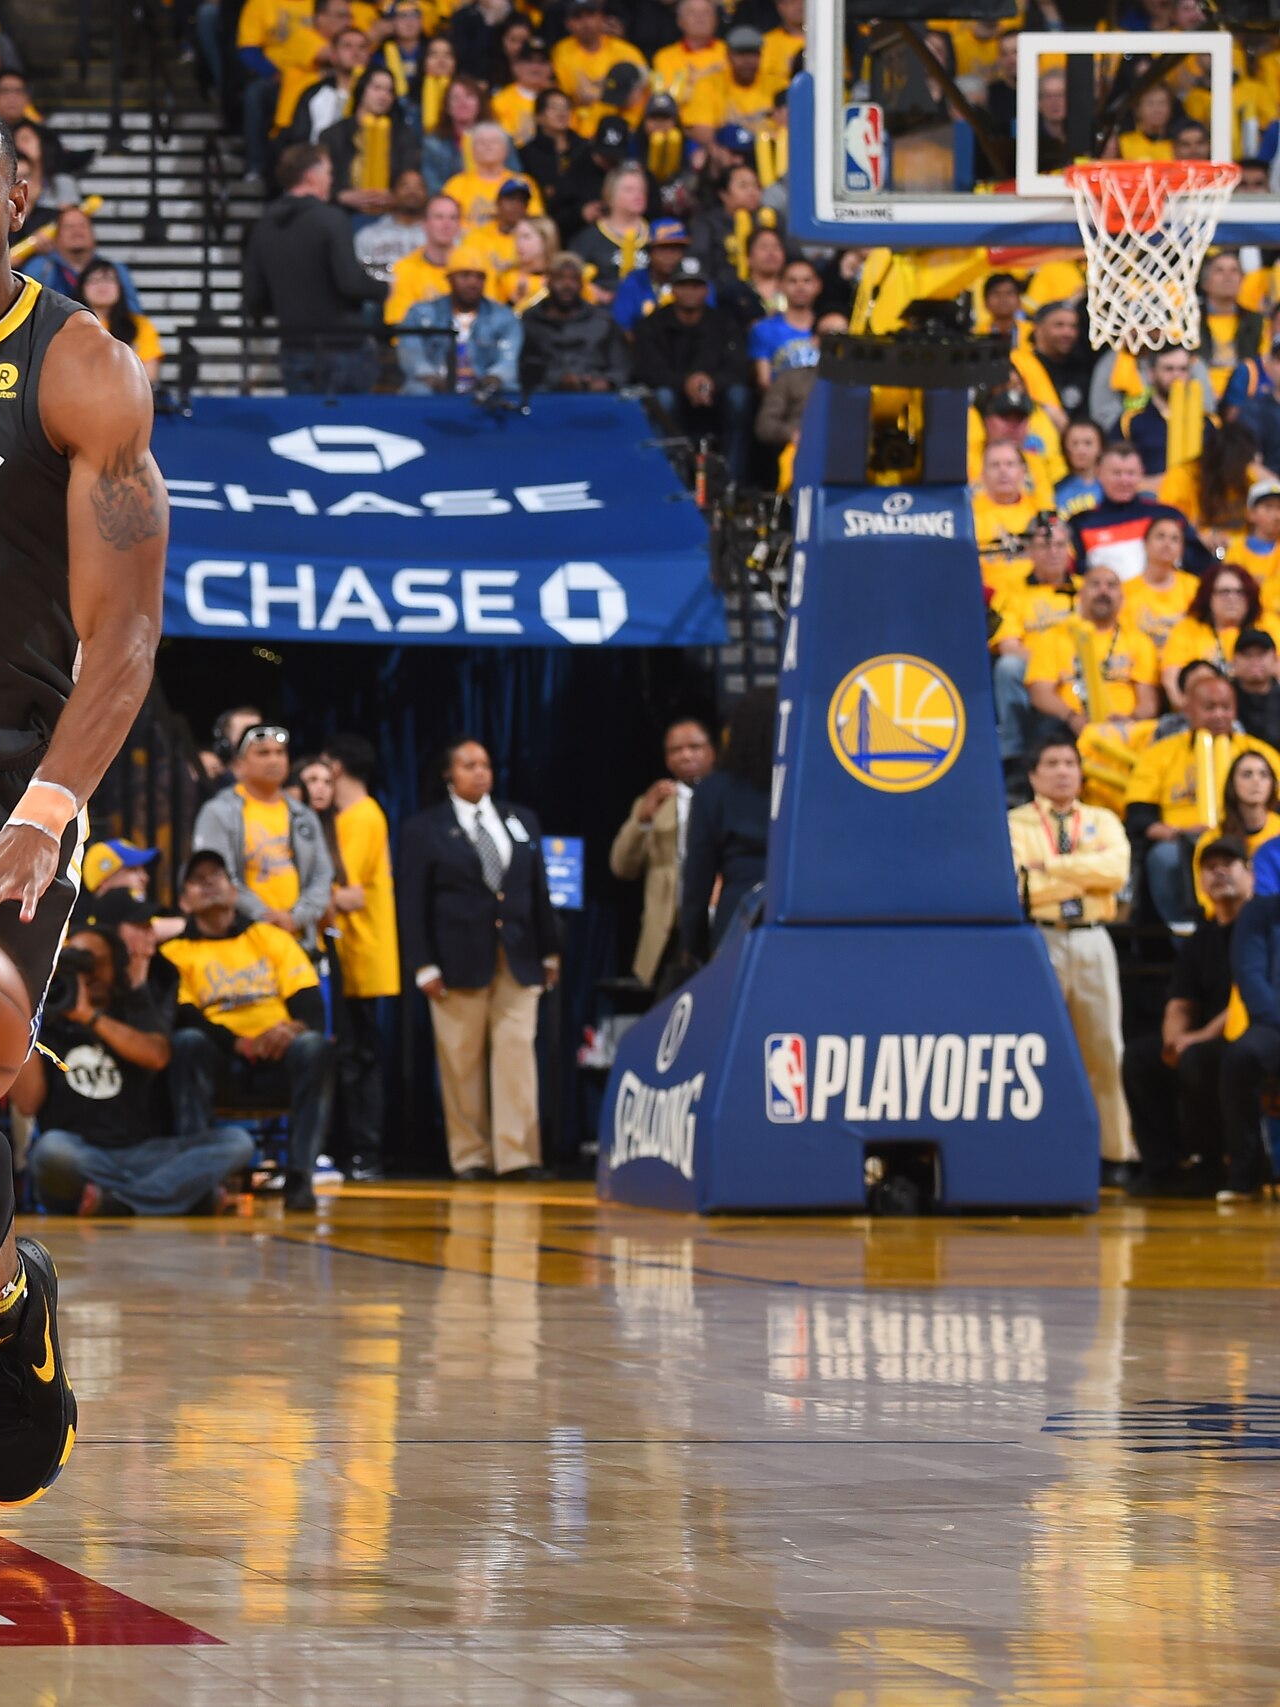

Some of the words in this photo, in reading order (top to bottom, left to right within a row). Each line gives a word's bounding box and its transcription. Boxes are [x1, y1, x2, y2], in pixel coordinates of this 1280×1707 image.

[834, 208, 893, 220] SPALDING
[844, 508, 955, 539] SPALDING
[185, 560, 524, 634] CHASE
[811, 1033, 1047, 1122] PLAYOFFS
[609, 1071, 706, 1180] SPALDING
